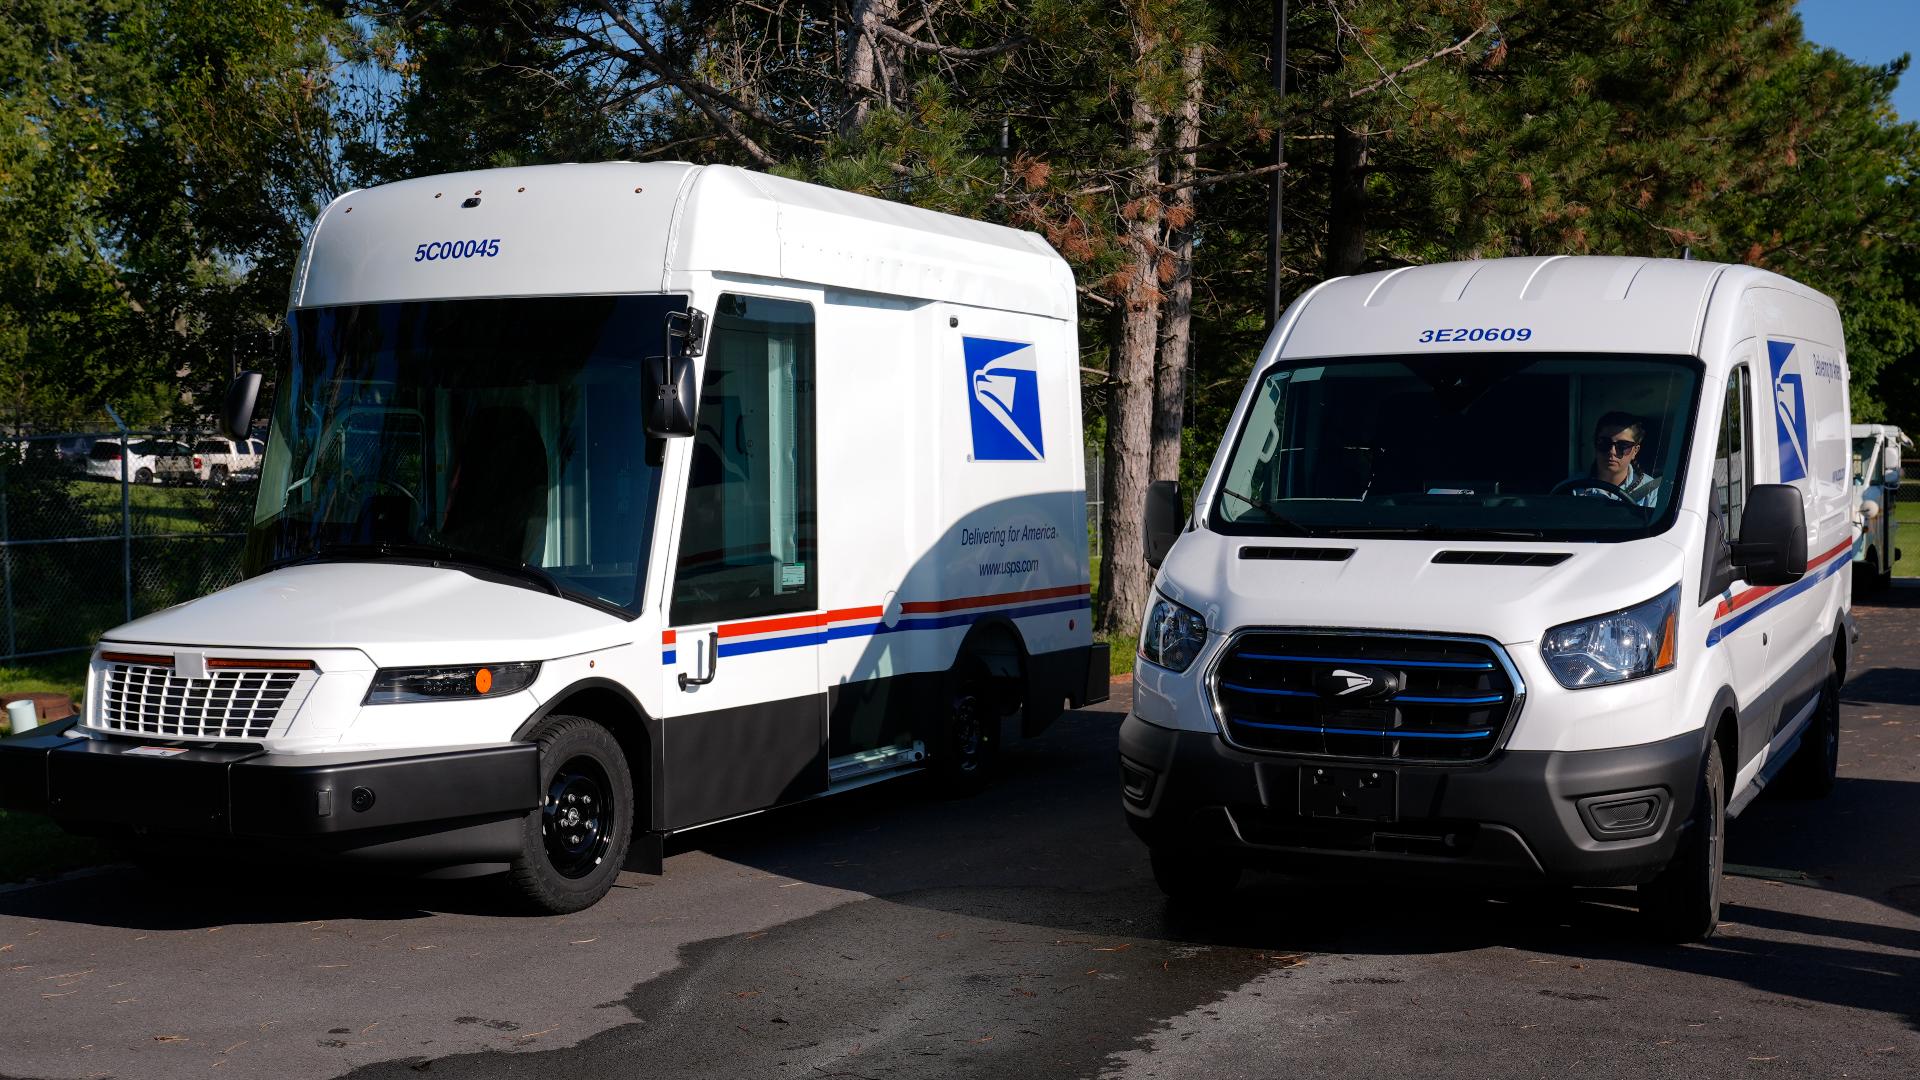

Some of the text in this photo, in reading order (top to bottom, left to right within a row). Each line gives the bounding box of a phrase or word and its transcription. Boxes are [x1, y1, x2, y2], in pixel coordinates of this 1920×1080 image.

[415, 239, 501, 262] 5C00045
[1419, 328, 1532, 343] 3E20609
[961, 527, 1006, 547] Delivering
[1008, 526, 1020, 543] for
[979, 560, 1039, 577] www.usps.com
